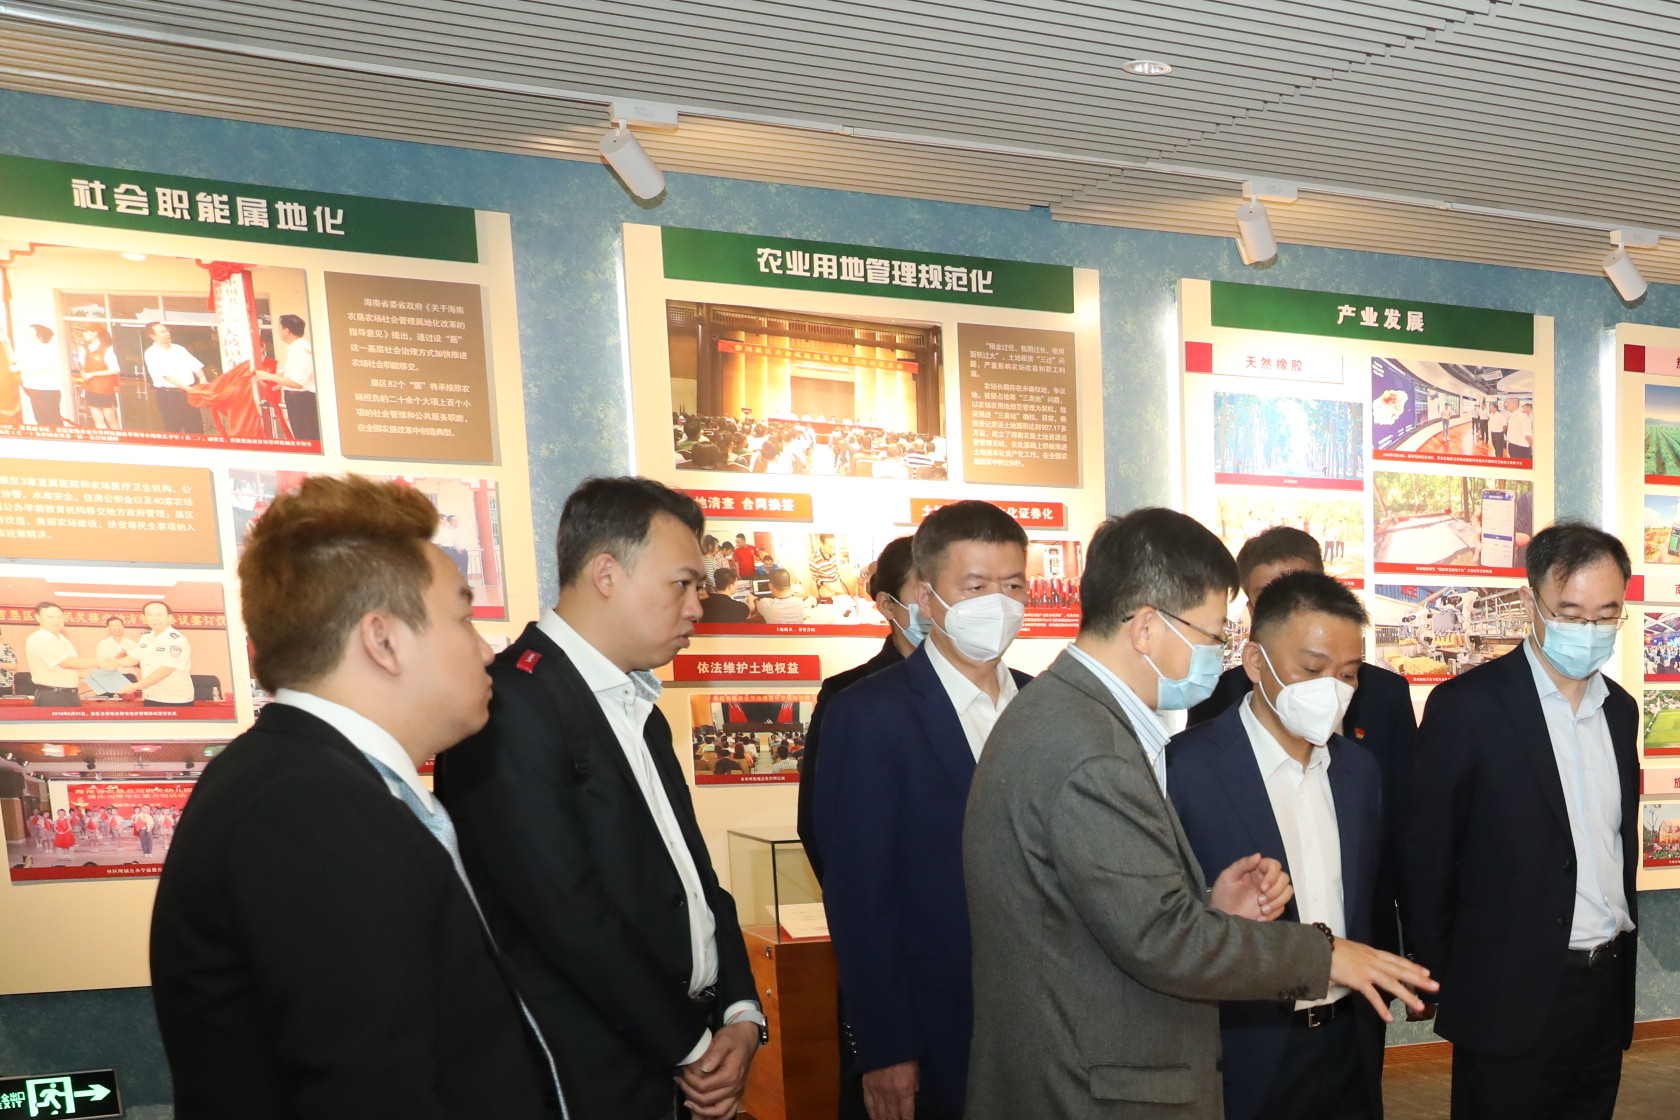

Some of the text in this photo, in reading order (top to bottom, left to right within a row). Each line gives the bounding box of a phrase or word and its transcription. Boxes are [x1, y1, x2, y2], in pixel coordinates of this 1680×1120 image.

[71, 178, 346, 236] 社会职能属地化
[757, 246, 995, 295] 农业用地管理规范化
[1338, 304, 1425, 332] 产业发展
[1245, 355, 1304, 374] 天然橡胶
[742, 497, 796, 513] 合同换签
[697, 661, 800, 675] 依法维护土地权益
[0, 1091, 26, 1103] 全出口
